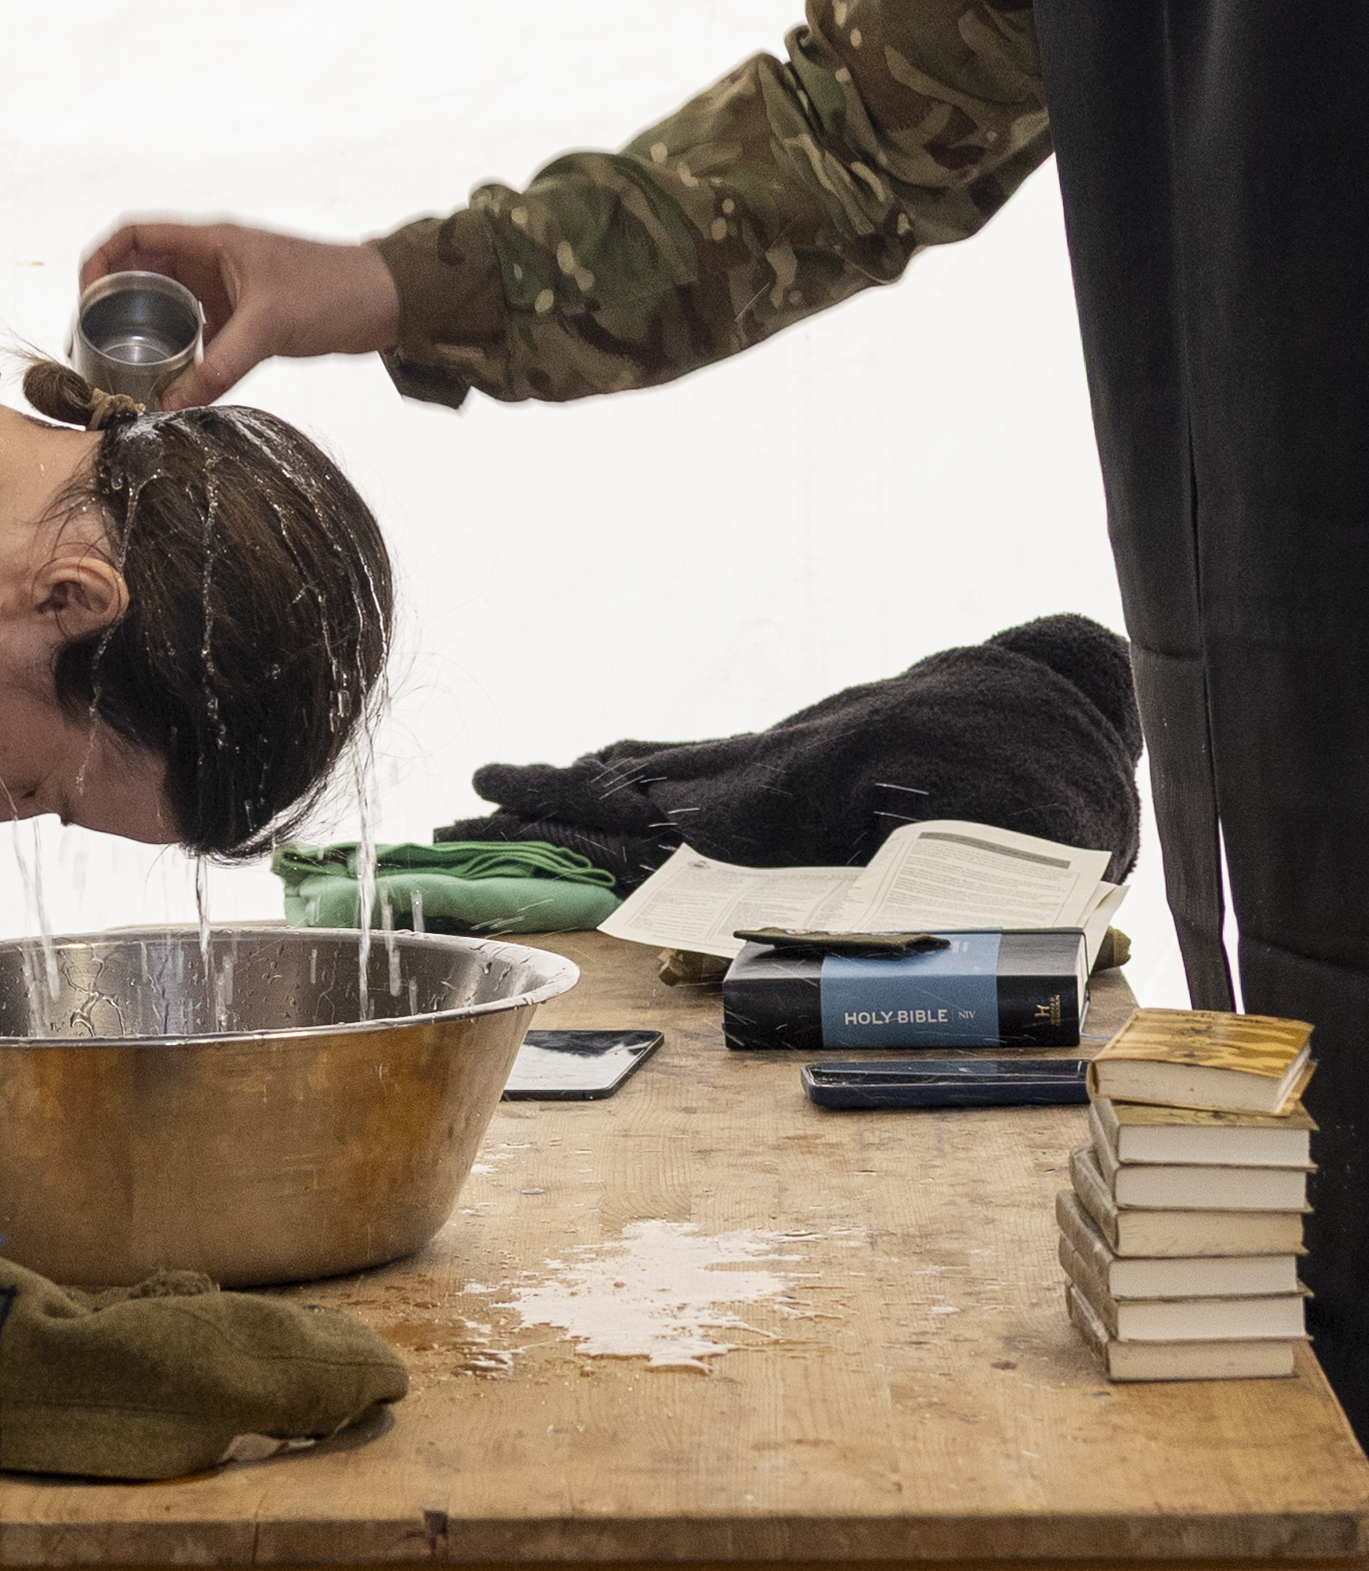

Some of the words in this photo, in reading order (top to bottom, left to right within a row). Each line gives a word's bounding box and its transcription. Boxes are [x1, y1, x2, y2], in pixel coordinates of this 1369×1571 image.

[844, 1011, 894, 1025] HOLY
[897, 1009, 949, 1024] BIBLE
[958, 1010, 976, 1020] NIV
